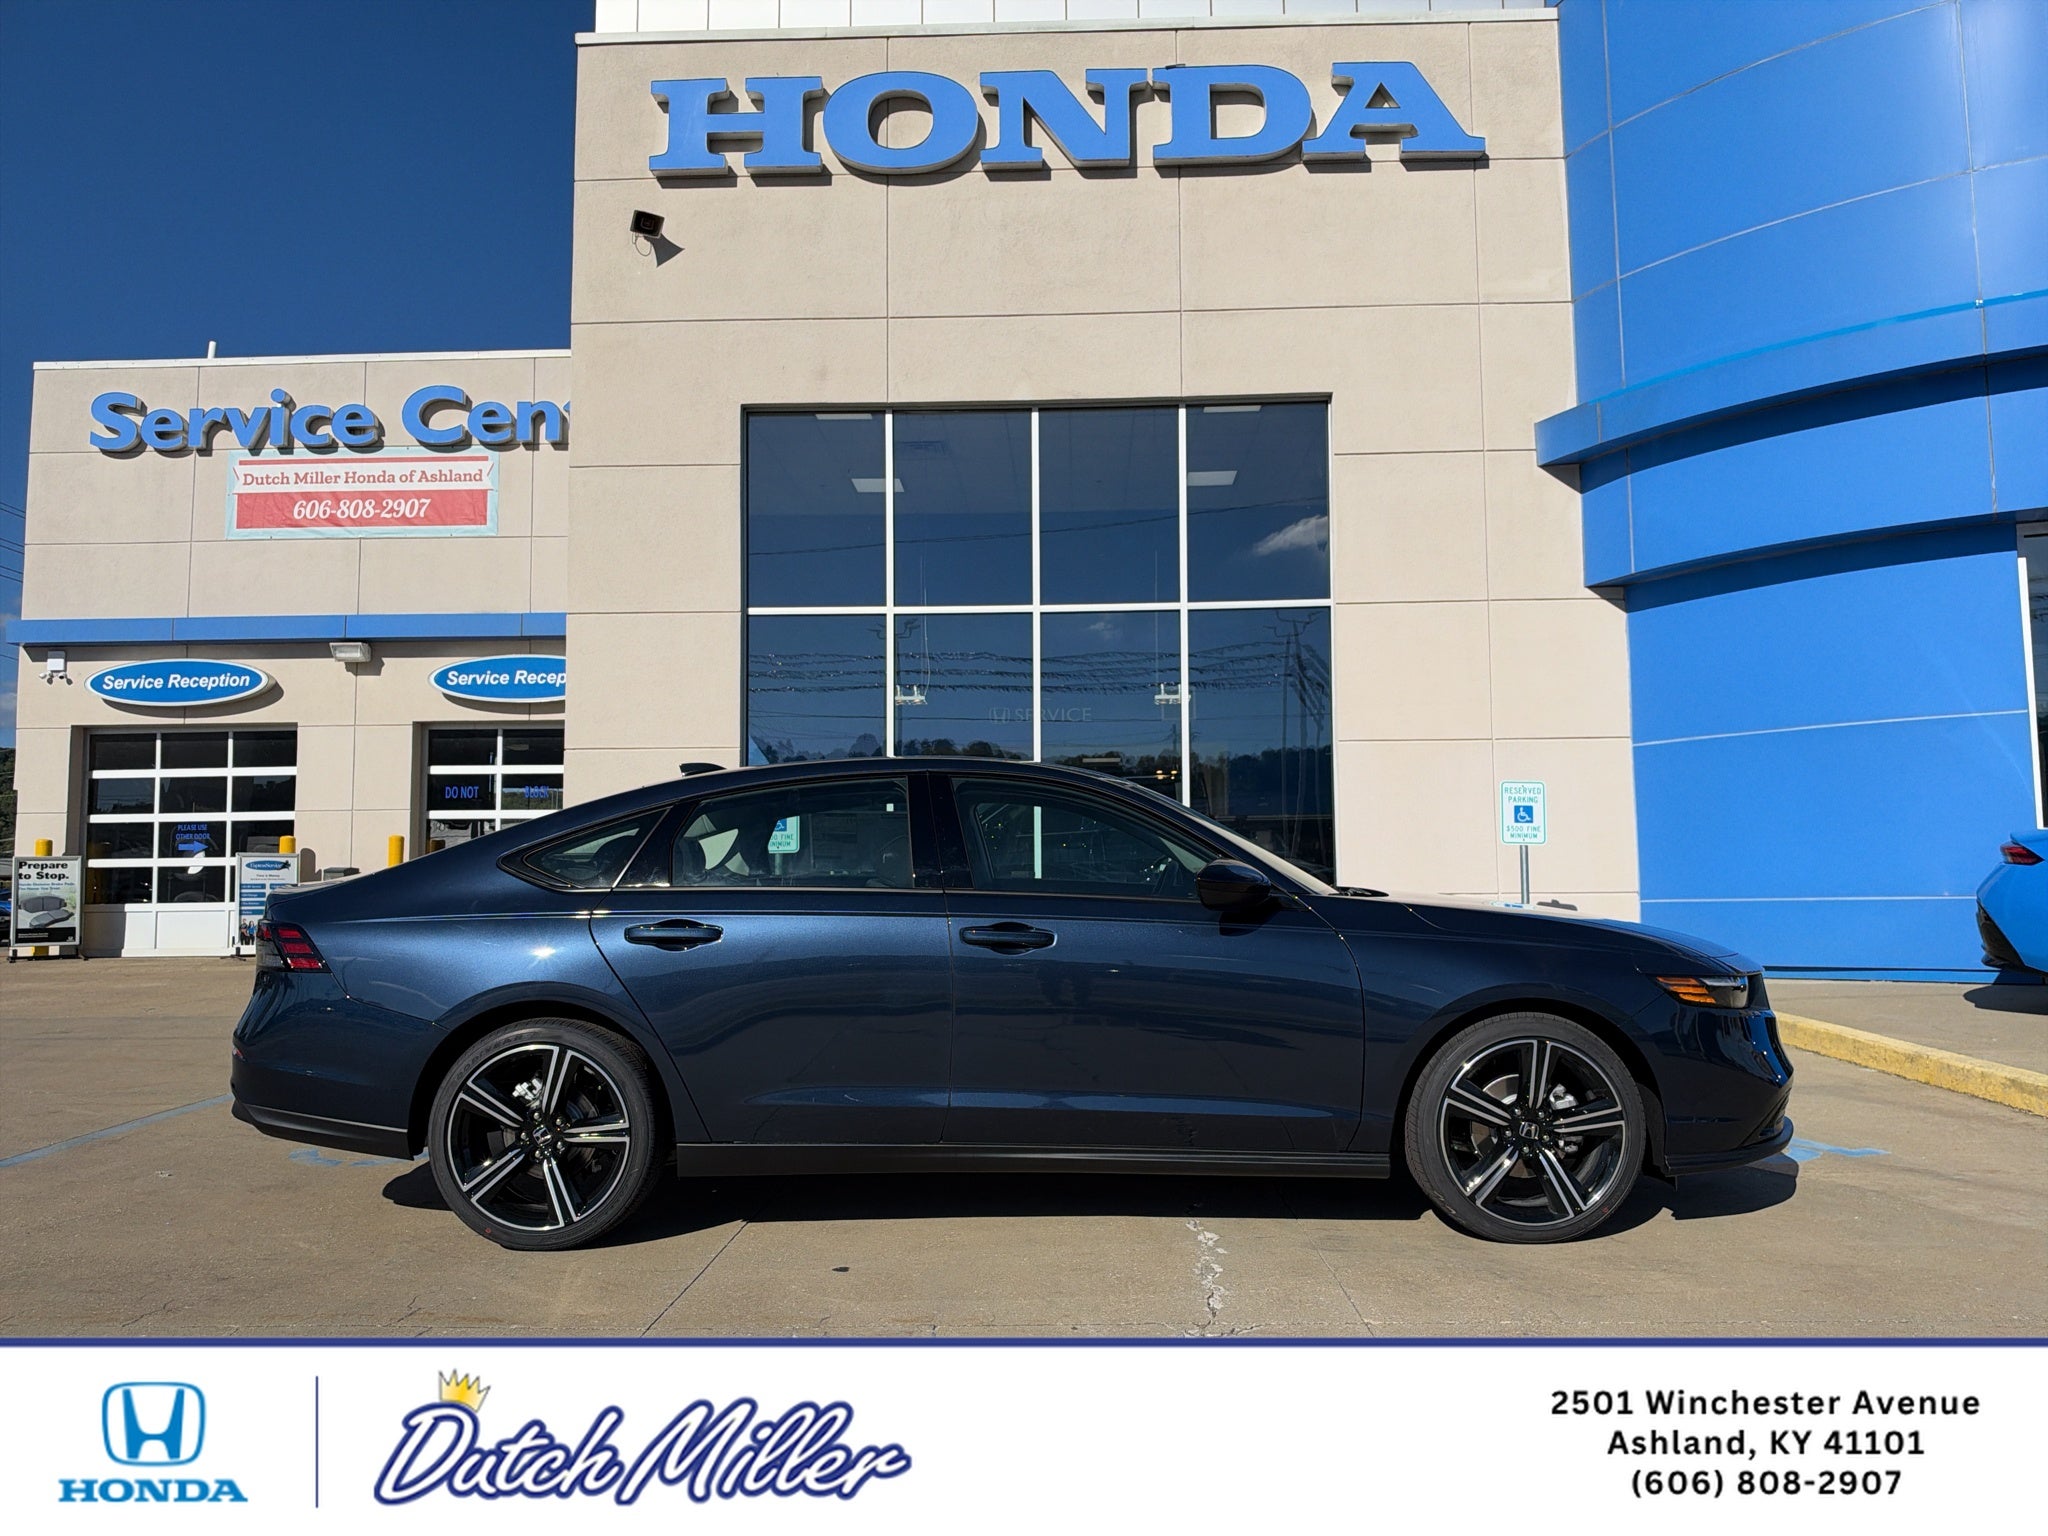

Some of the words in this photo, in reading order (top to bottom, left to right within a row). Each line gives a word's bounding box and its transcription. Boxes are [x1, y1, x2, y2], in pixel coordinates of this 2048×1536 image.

[649, 61, 1486, 171] HONDA
[90, 388, 374, 450] Service
[401, 384, 570, 444] Cen
[242, 472, 290, 486] Dutch
[293, 471, 341, 485] Miller
[344, 470, 396, 484] Honda
[399, 469, 417, 483] of
[417, 469, 483, 483] Ashland
[293, 498, 431, 519] 606-808-2907
[102, 674, 163, 690] Service
[167, 673, 250, 691] Reception
[446, 670, 510, 686] Service
[513, 670, 567, 687] Recep
[445, 786, 459, 799] DO
[460, 786, 479, 799] NOT
[1504, 787, 1542, 795] RESERVED
[18, 861, 68, 871] Prepare
[18, 872, 31, 880] to
[36, 871, 69, 881] Stop.
